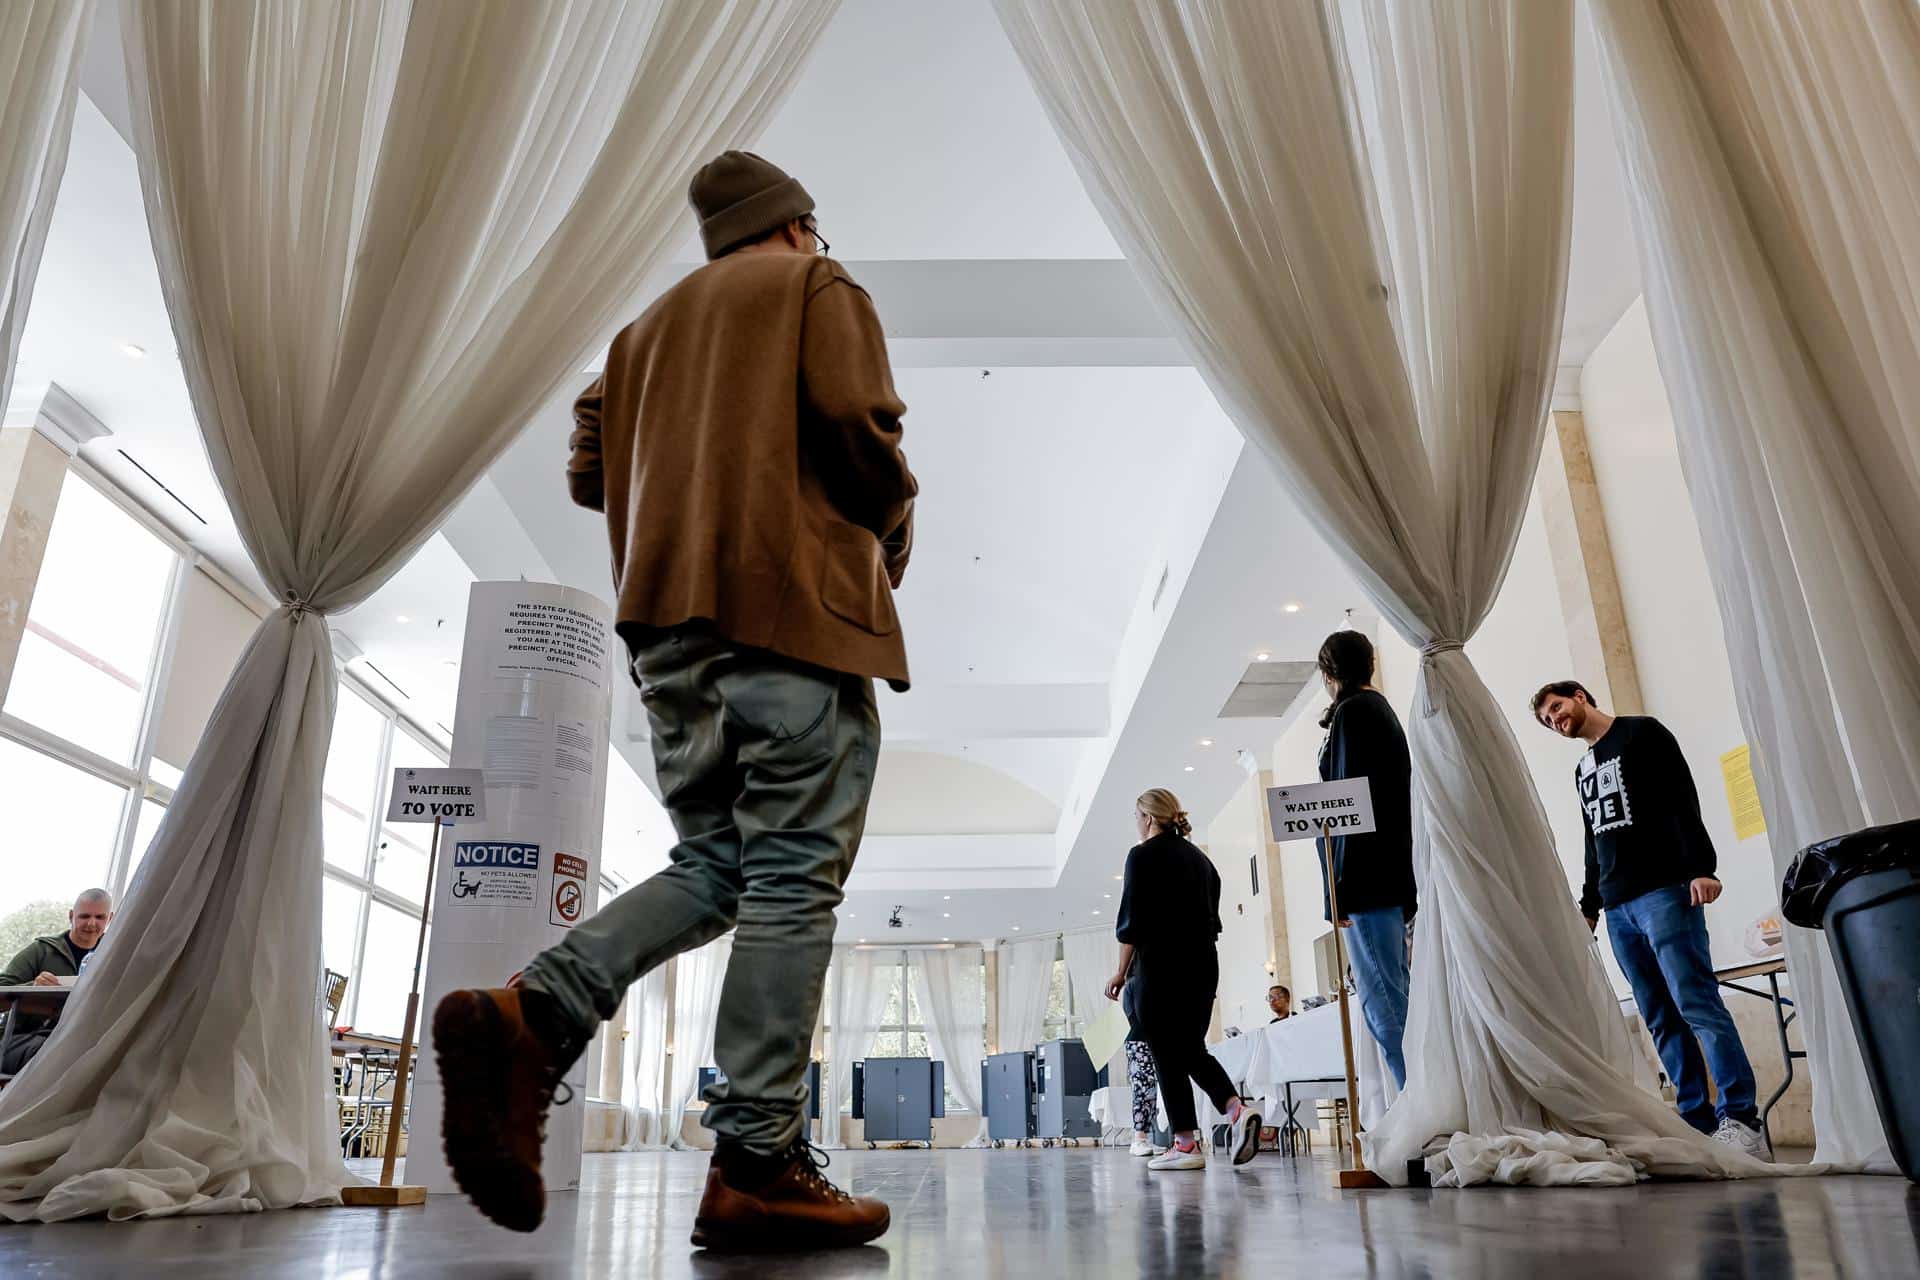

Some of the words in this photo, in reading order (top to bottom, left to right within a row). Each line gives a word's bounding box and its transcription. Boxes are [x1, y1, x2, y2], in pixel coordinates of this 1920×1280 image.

[549, 614, 564, 622] YOU
[517, 620, 554, 628] PRECINCT
[556, 624, 579, 633] WHERE
[563, 641, 575, 649] THE
[549, 647, 575, 658] PLEASE
[408, 785, 440, 795] WAIT
[442, 786, 471, 795] HERE
[402, 802, 425, 815] TO
[430, 803, 475, 817] VOTE
[1285, 801, 1318, 813] WAIT
[1320, 798, 1354, 810] HERE
[1284, 819, 1309, 832] TO
[1312, 814, 1361, 830] VOTE
[456, 845, 537, 865] NOTICE
